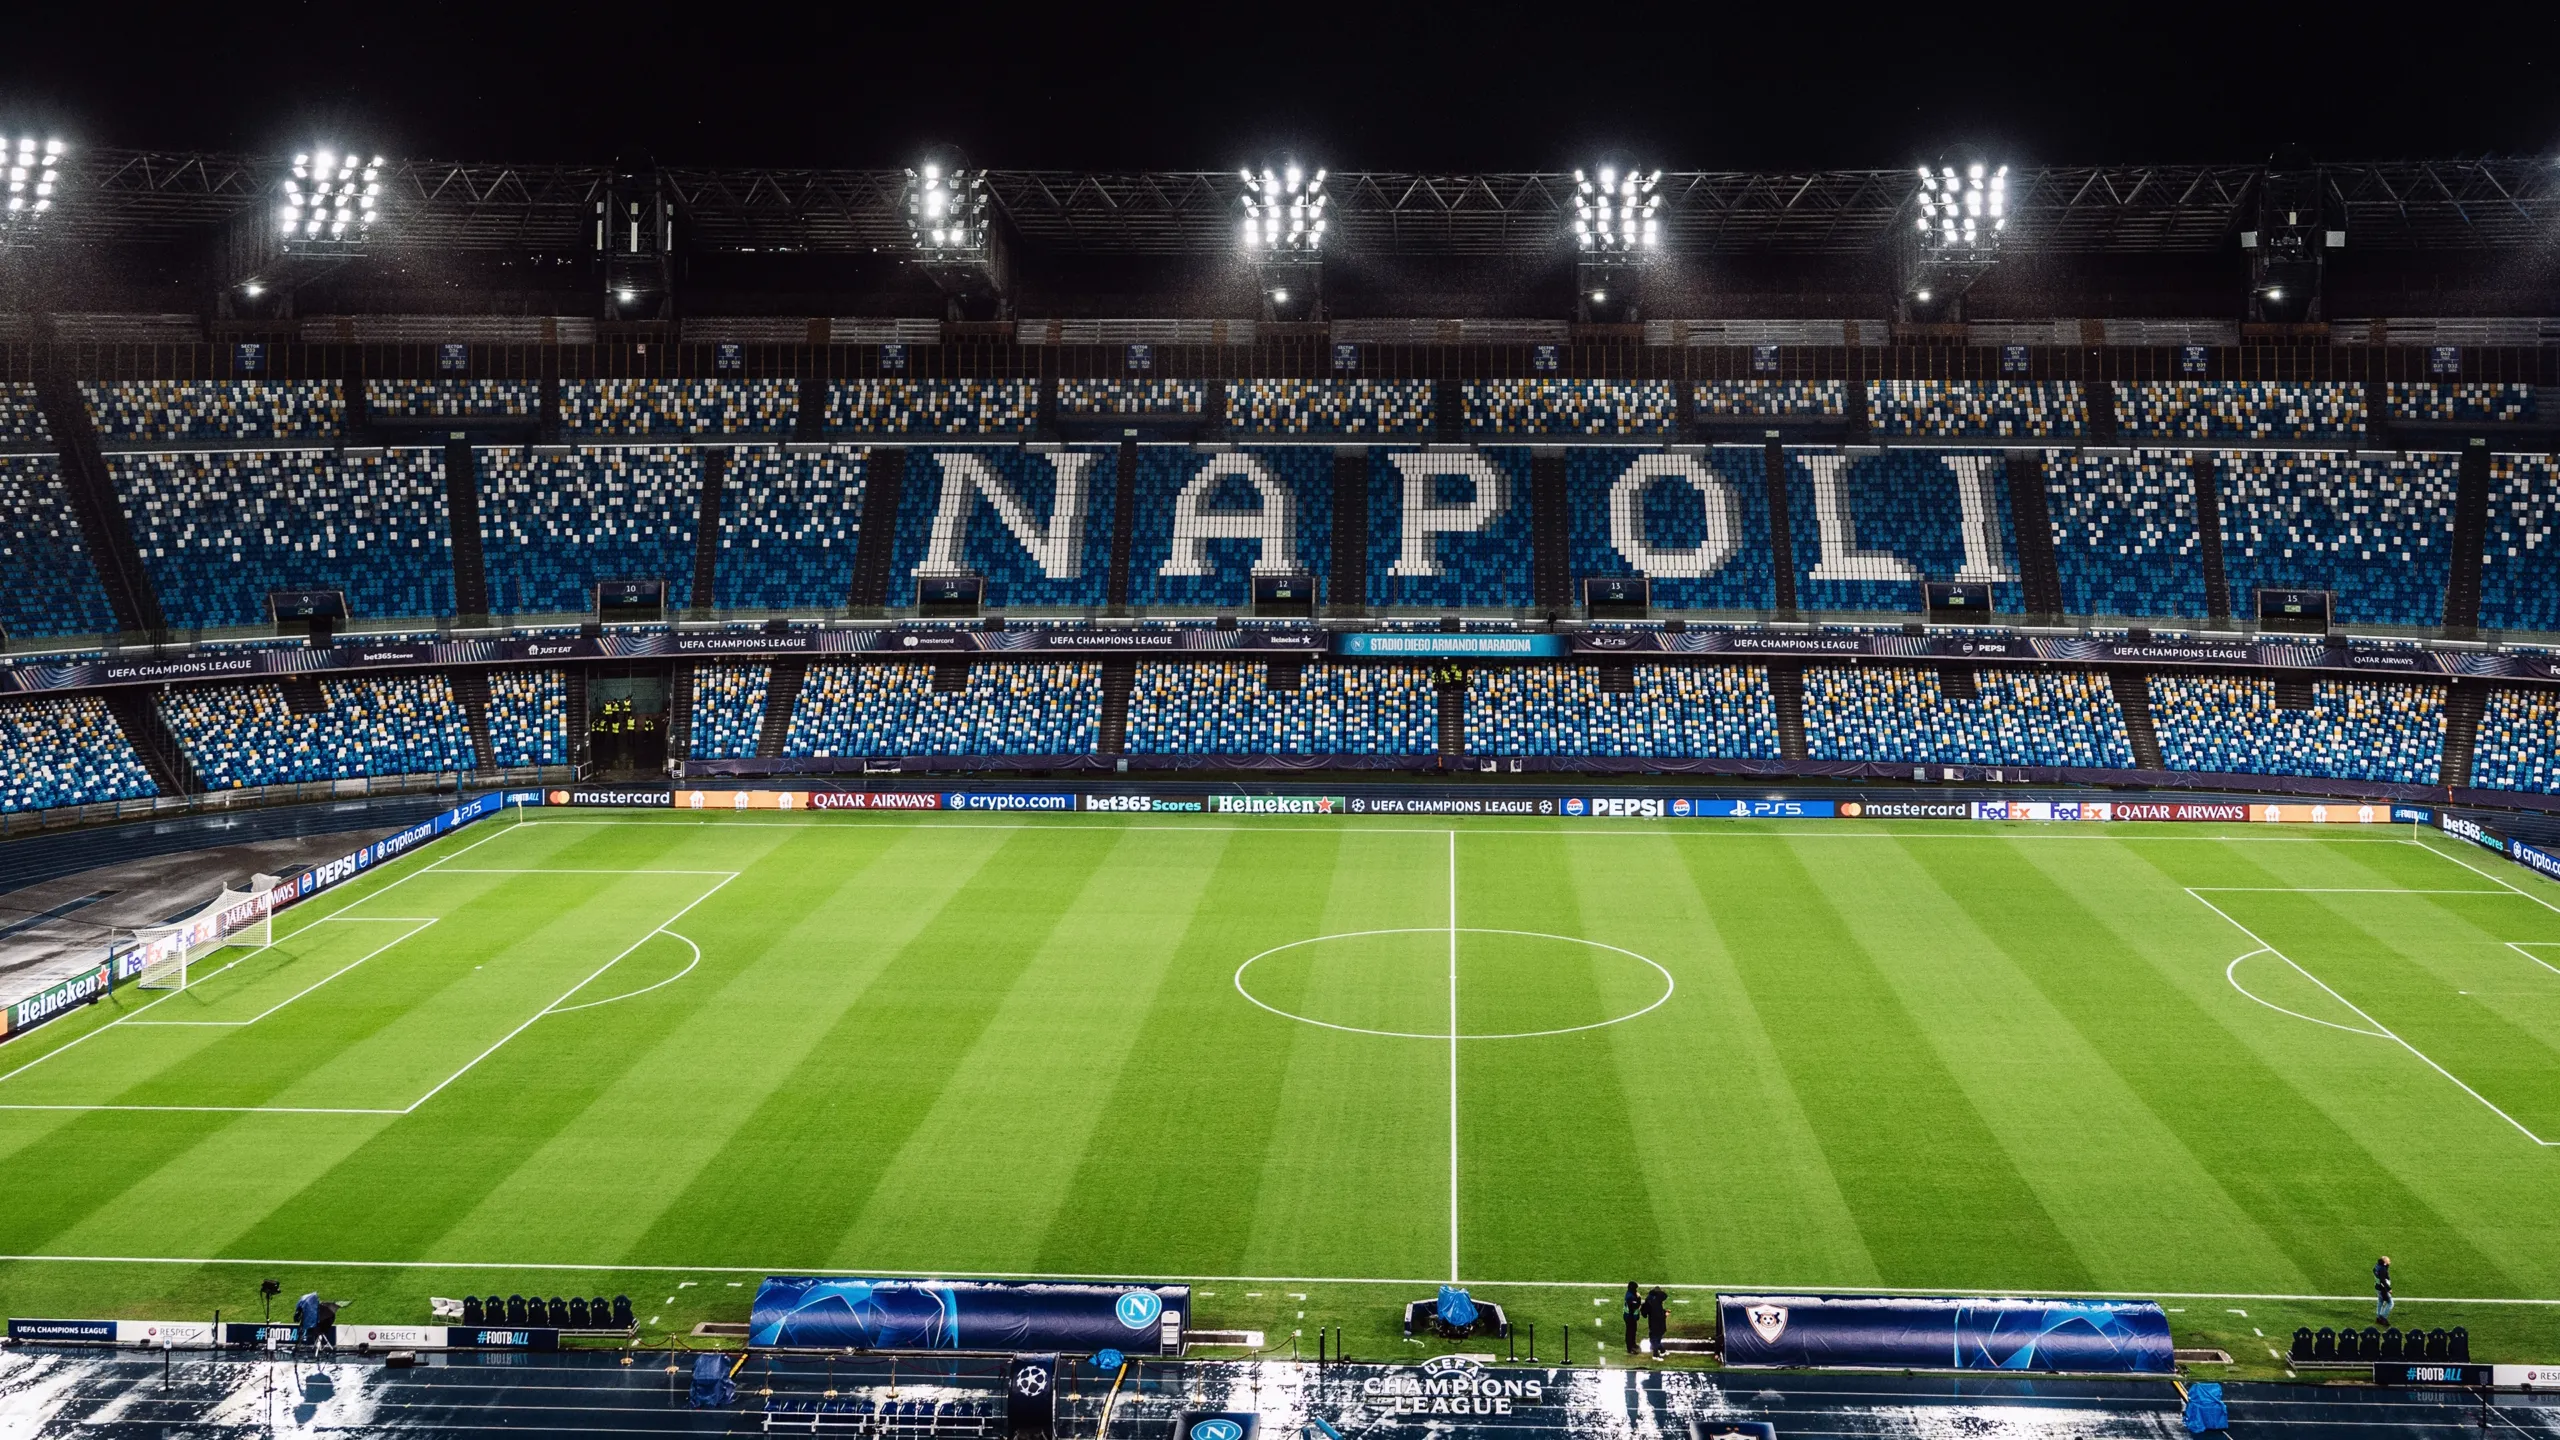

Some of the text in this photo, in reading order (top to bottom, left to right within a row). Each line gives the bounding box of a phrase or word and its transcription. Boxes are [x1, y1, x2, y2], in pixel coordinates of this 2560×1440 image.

[911, 453, 2014, 582] NAPOLI
[680, 638, 807, 649] UEFA CHAMPIONS LEAGUE
[1050, 636, 1173, 645] UEFA CHAMPIONS LEAGUE
[1271, 635, 1300, 643] Heineken
[1370, 638, 1531, 652] STADIO DIEGO ARMANDO MARADONA
[1734, 639, 1859, 649] UEFA CHAMPIONS LEAGUE
[364, 652, 392, 660] bet365
[540, 646, 556, 654] JUST
[2114, 647, 2247, 659] UEFA CHAMPIONS LEAGUE
[2354, 656, 2414, 665] QATAR AIRWAYS
[108, 660, 252, 678] UEFA CHAMPIONS LEAGUE
[574, 791, 670, 805] mastercard
[814, 794, 936, 808] QATAR AIRWAYS
[970, 794, 1066, 810] crypto.com
[1086, 795, 1202, 811] bet365 Scores
[1218, 795, 1315, 813] Heineken
[461, 801, 482, 820] PS5
[1371, 800, 1533, 813] UEFA CHAMPIONS LEAGUE
[1592, 799, 1664, 816] PEPSI
[1755, 803, 1802, 815] PS5
[1866, 802, 1966, 817] mastercard
[1978, 802, 2030, 819] FedEx
[2051, 802, 2102, 820] FedEx
[2117, 805, 2244, 821] QATAR AIRWAYS
[386, 823, 431, 853] crypto.com
[2443, 813, 2504, 851] bet365 Scores
[316, 855, 356, 888] PEPSI
[17, 975, 96, 1027] Heineken
[37, 1326, 79, 1334] CHAMPIONS
[80, 1327, 108, 1335] LEAGUE
[160, 1328, 196, 1336] RESPECT
[380, 1332, 416, 1341] RESPECT
[477, 1331, 529, 1345] #FOOTBALL
[1424, 1358, 1479, 1378] UEFA
[2406, 1367, 2463, 1381] #FOOTBALL
[1364, 1378, 1542, 1396] CHAMPIONS
[1394, 1396, 1512, 1415] LEAGUE
